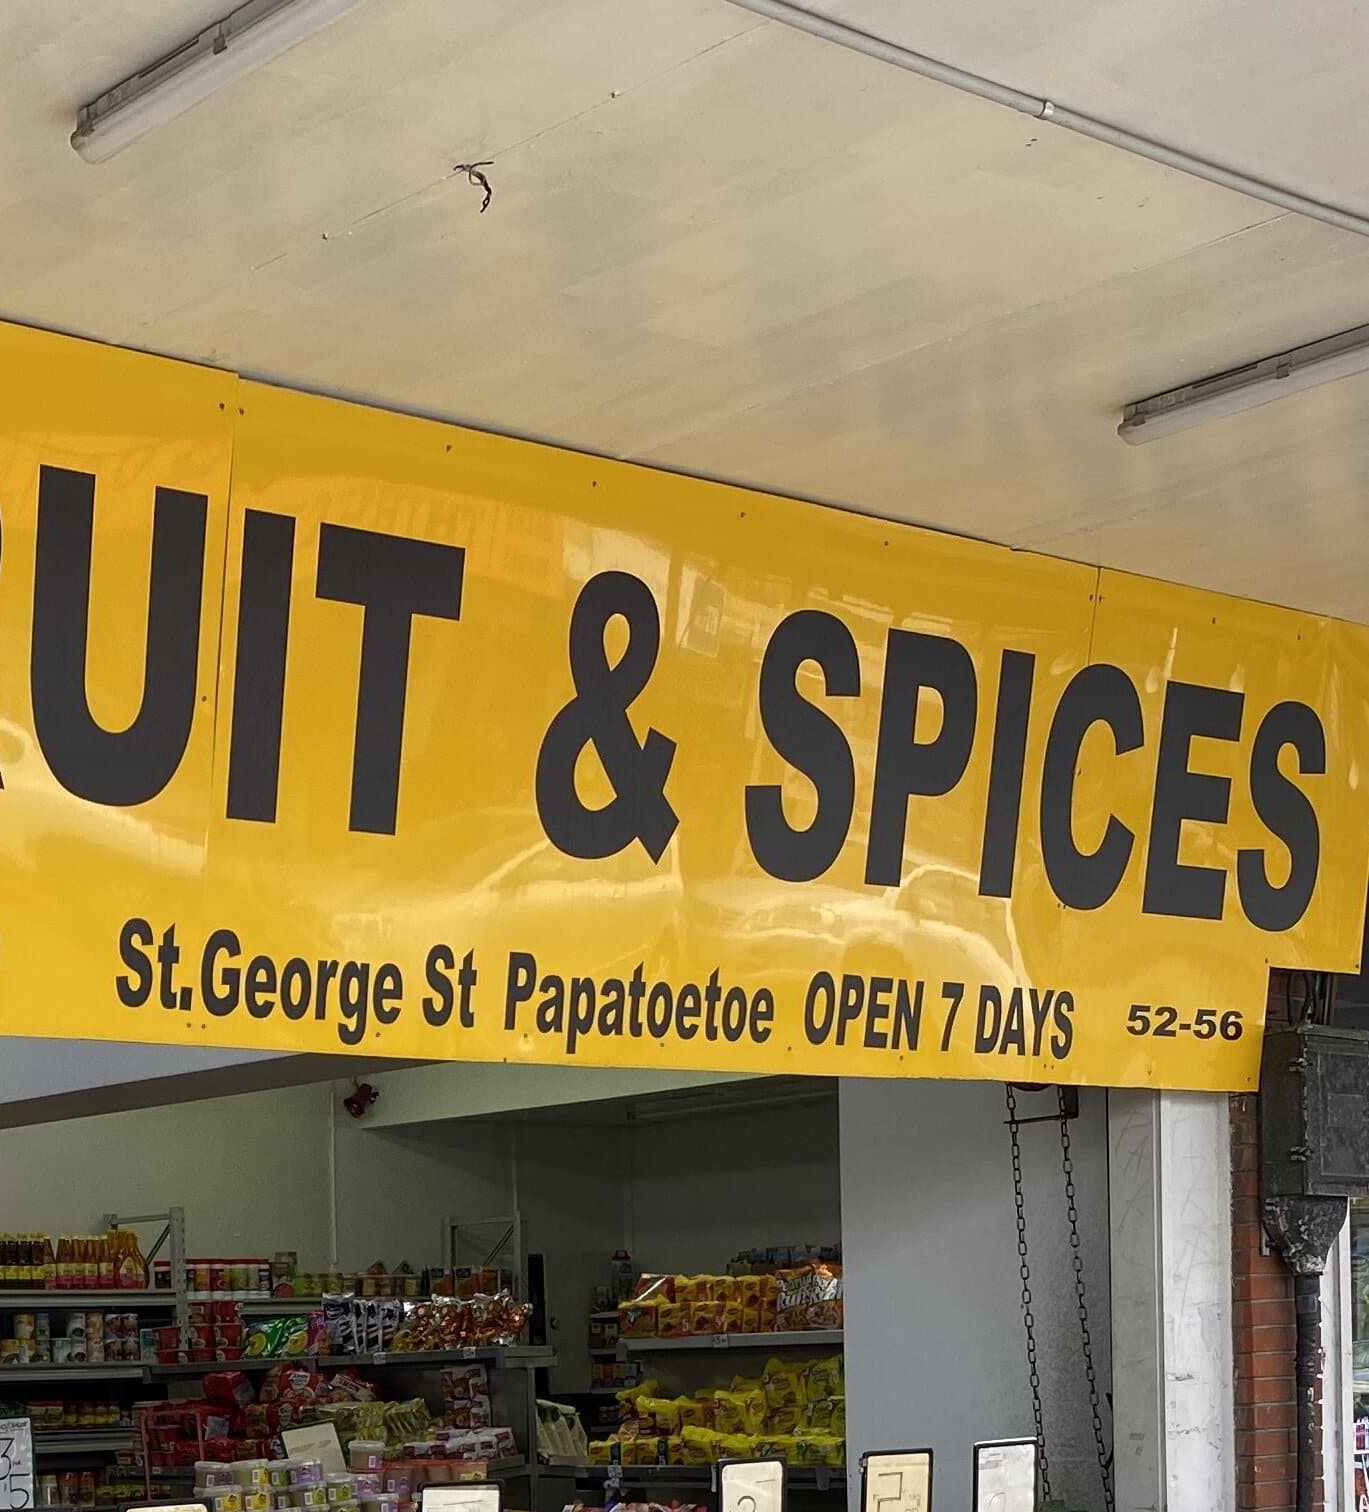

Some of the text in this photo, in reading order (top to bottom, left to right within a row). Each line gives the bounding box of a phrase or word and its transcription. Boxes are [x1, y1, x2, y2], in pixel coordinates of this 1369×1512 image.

[535, 570, 681, 866] &
[744, 609, 1327, 932] SPICES
[116, 918, 1075, 1060] St.George St Papatoetoe OPEN 7 DAYS
[1126, 1004, 1245, 1041] 52-56
